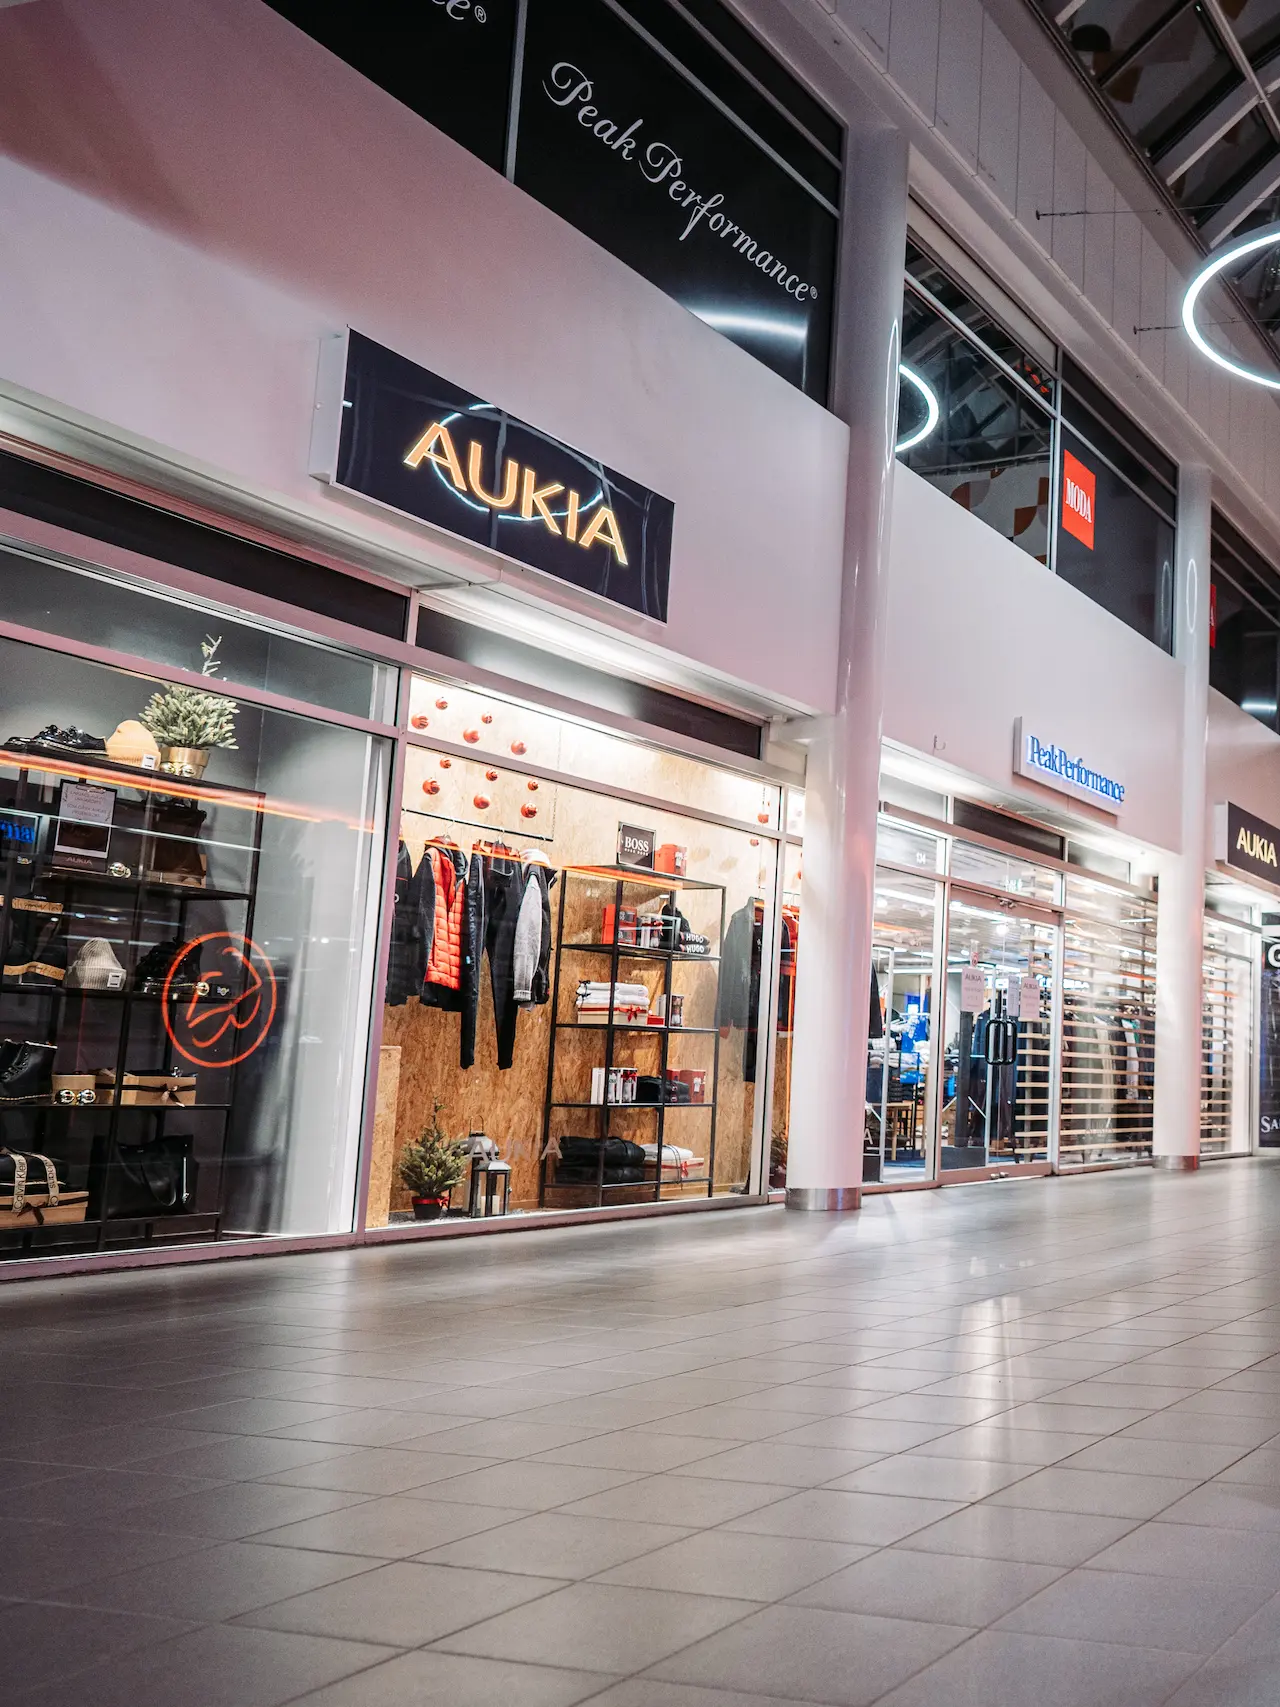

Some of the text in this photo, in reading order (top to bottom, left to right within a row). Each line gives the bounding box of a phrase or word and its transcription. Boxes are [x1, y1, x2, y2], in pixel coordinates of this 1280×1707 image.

[542, 62, 643, 160] Peak
[403, 422, 628, 565] AUKIA
[1066, 478, 1092, 523] MODA
[625, 836, 649, 852] BOSS
[1236, 827, 1277, 867] AUKIA
[686, 932, 703, 943] HUGO
[686, 943, 705, 953] HUGO
